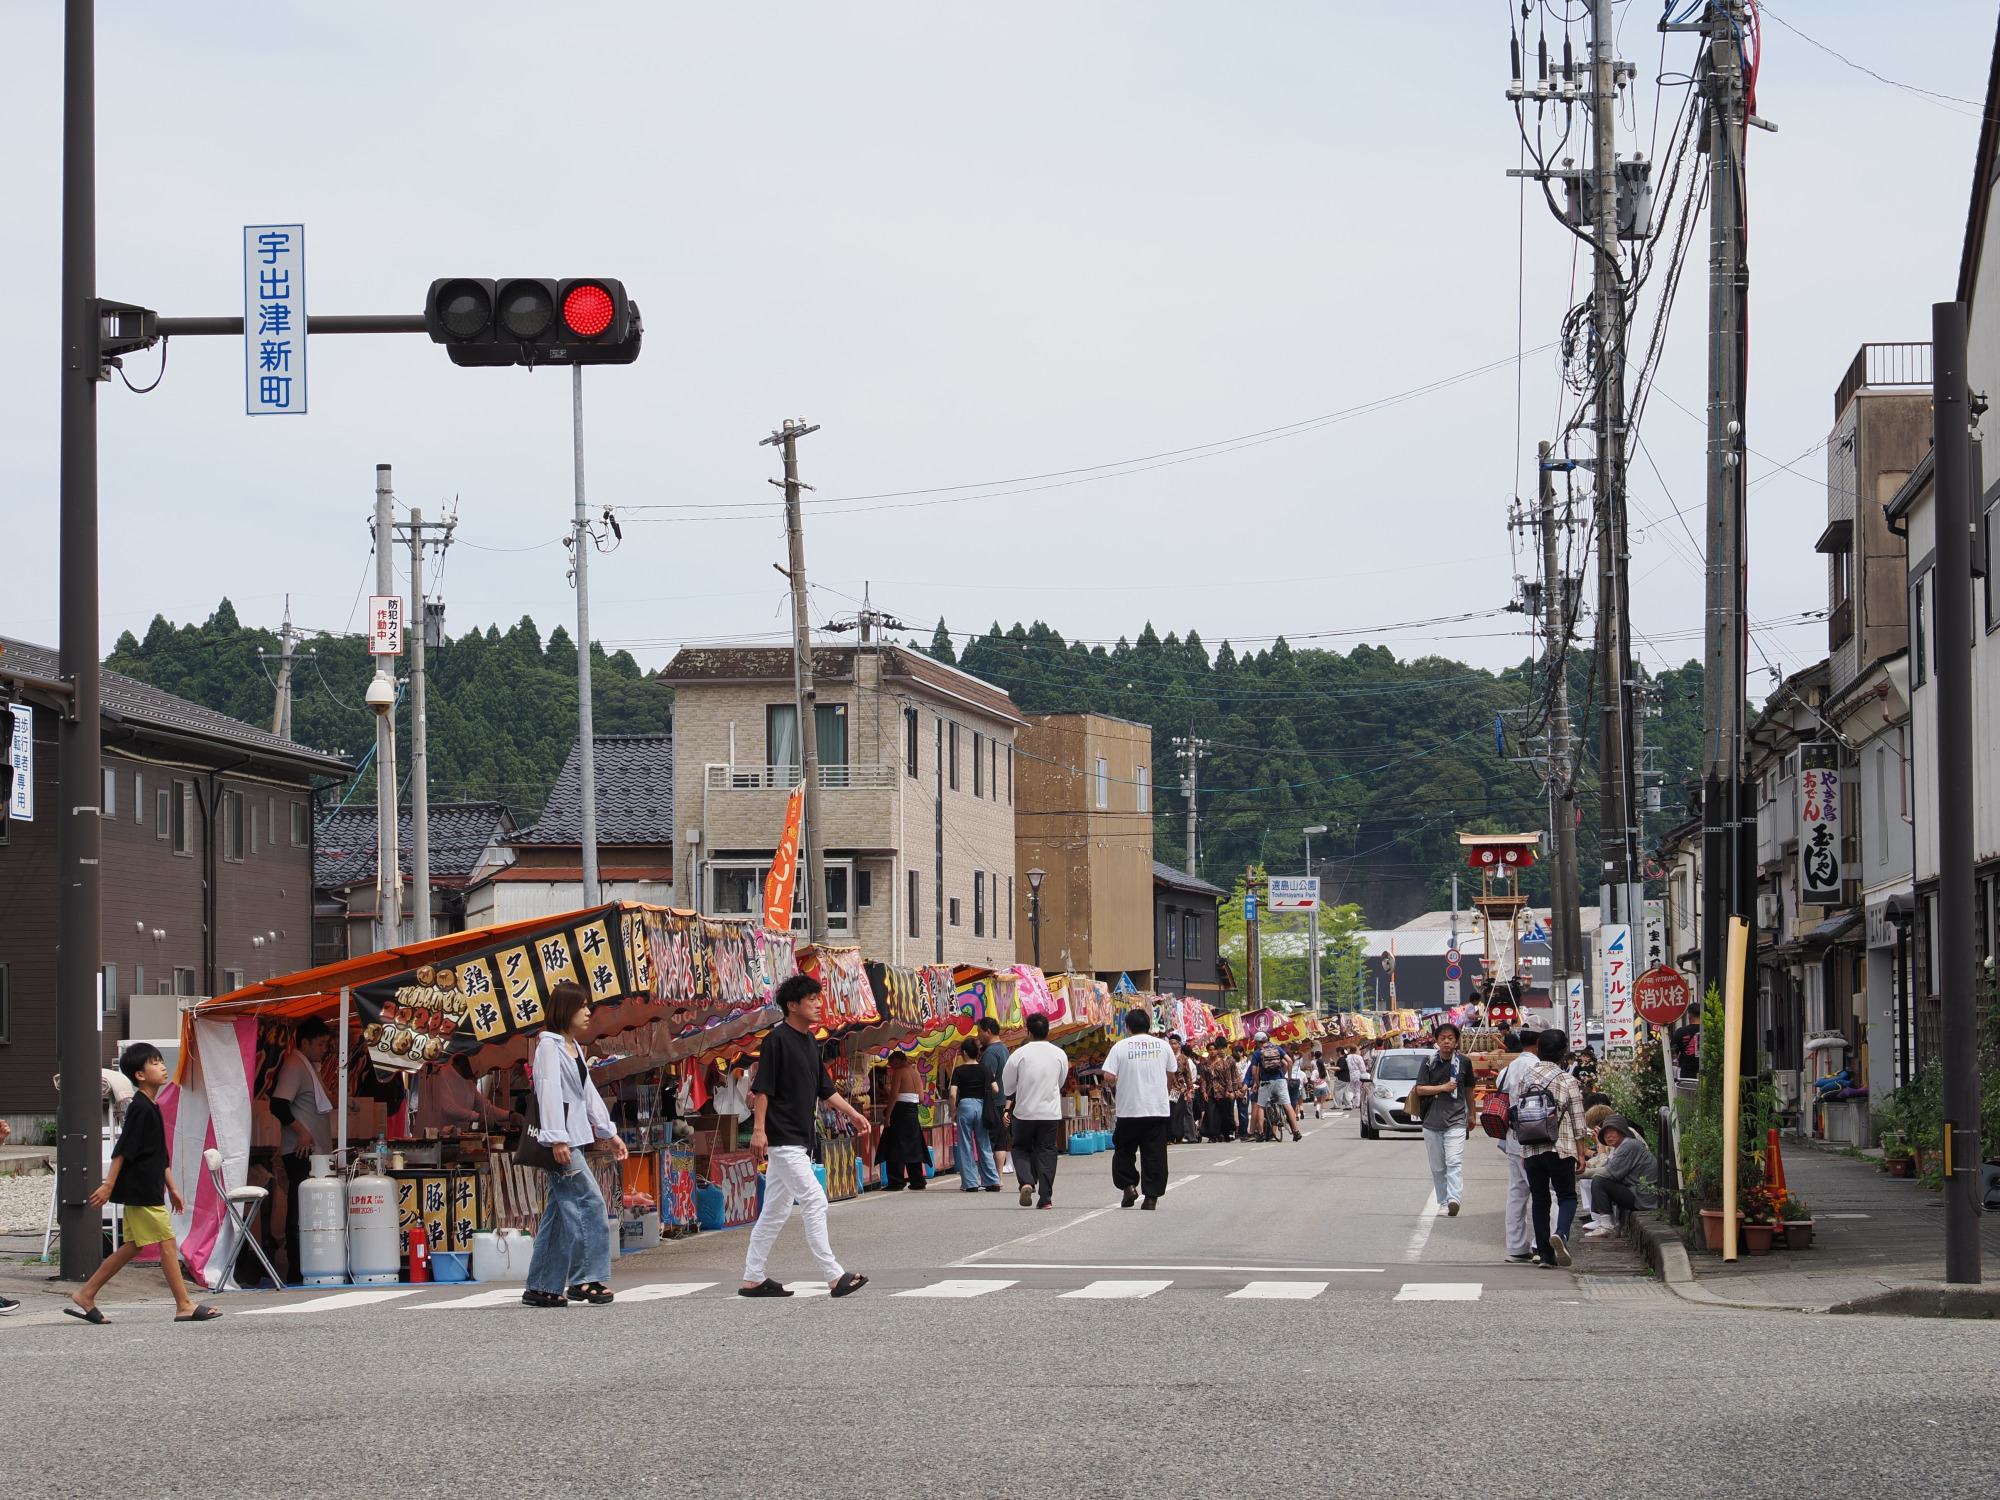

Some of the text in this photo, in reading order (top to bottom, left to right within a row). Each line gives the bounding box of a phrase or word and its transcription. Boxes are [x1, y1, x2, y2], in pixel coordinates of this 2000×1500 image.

[257, 231, 292, 408] 宇出津新町
[377, 609, 387, 641] 作動中
[388, 599, 398, 651] 防犯カメラ
[1803, 771, 1820, 822] おでん
[1820, 771, 1837, 822] やき鳥
[505, 952, 540, 1022] タン串
[541, 939, 572, 989] 豚
[582, 927, 614, 995] 牛串
[462, 965, 499, 1034] 鶏串
[1610, 961, 1626, 1015] アルプ
[1640, 984, 1686, 1011] 消火栓
[1572, 1000, 1582, 1031] アルプ
[425, 1181, 445, 1250] 豚串
[455, 1180, 474, 1249] 牛串
